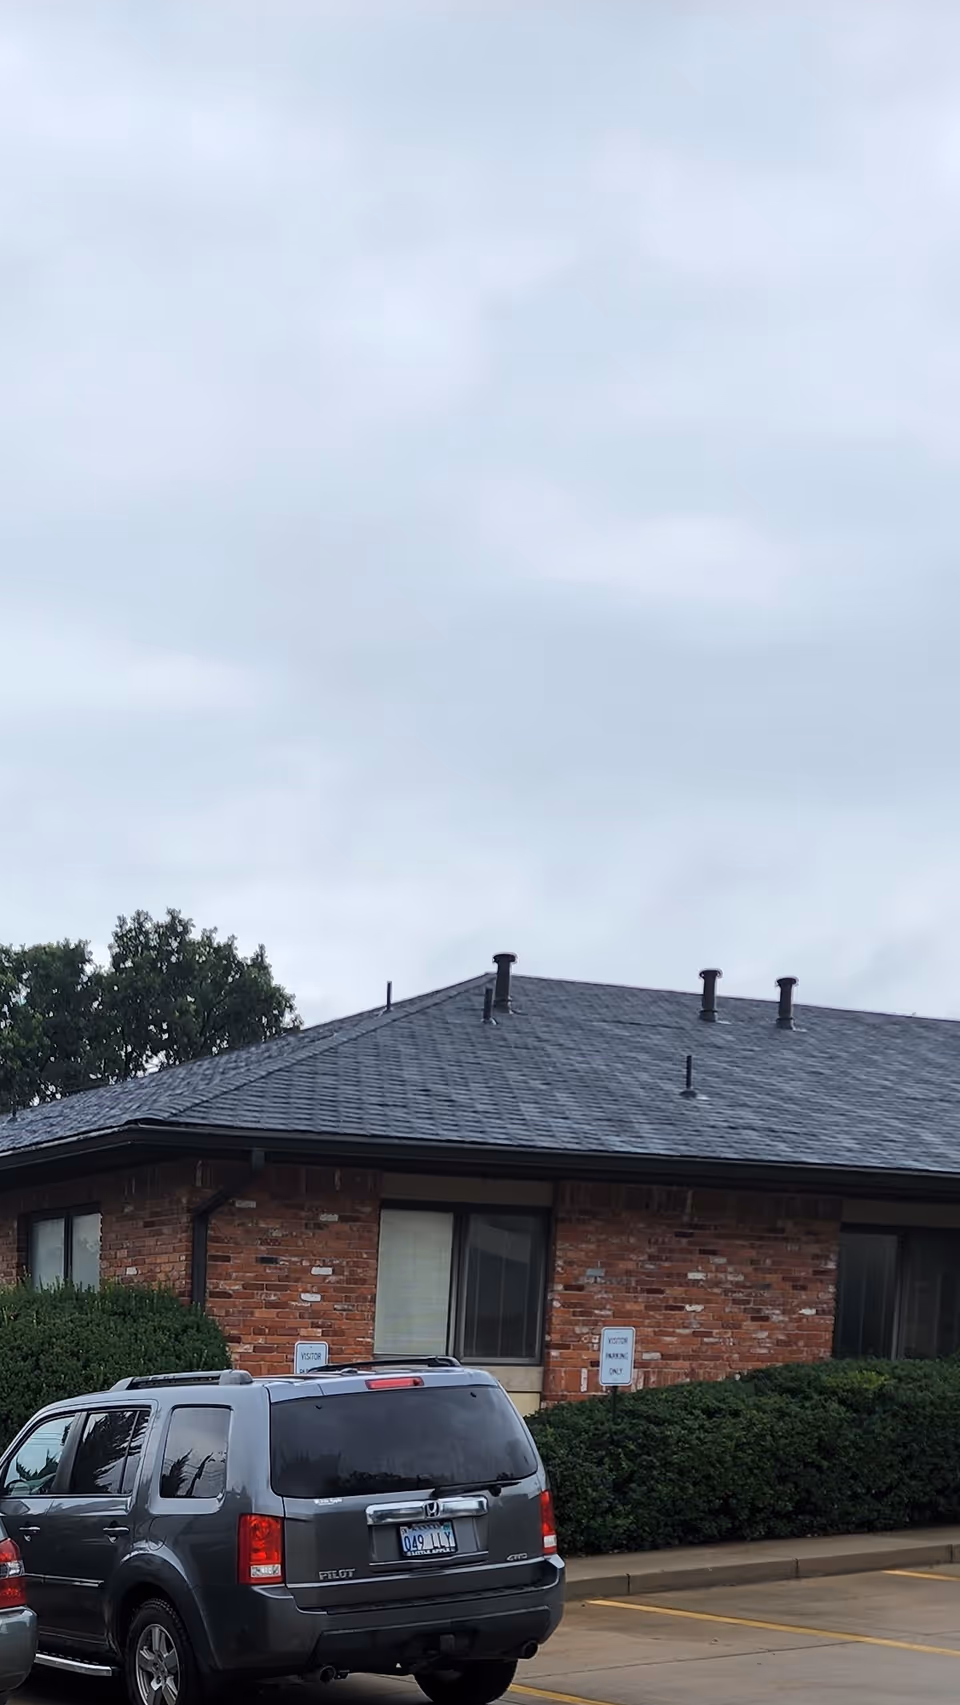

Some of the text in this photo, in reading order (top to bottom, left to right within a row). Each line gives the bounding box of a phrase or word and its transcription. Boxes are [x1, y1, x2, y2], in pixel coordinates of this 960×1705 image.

[301, 1352, 321, 1361] VISITOR
[404, 1534, 424, 1551] 049
[319, 1568, 356, 1580] PILOT
